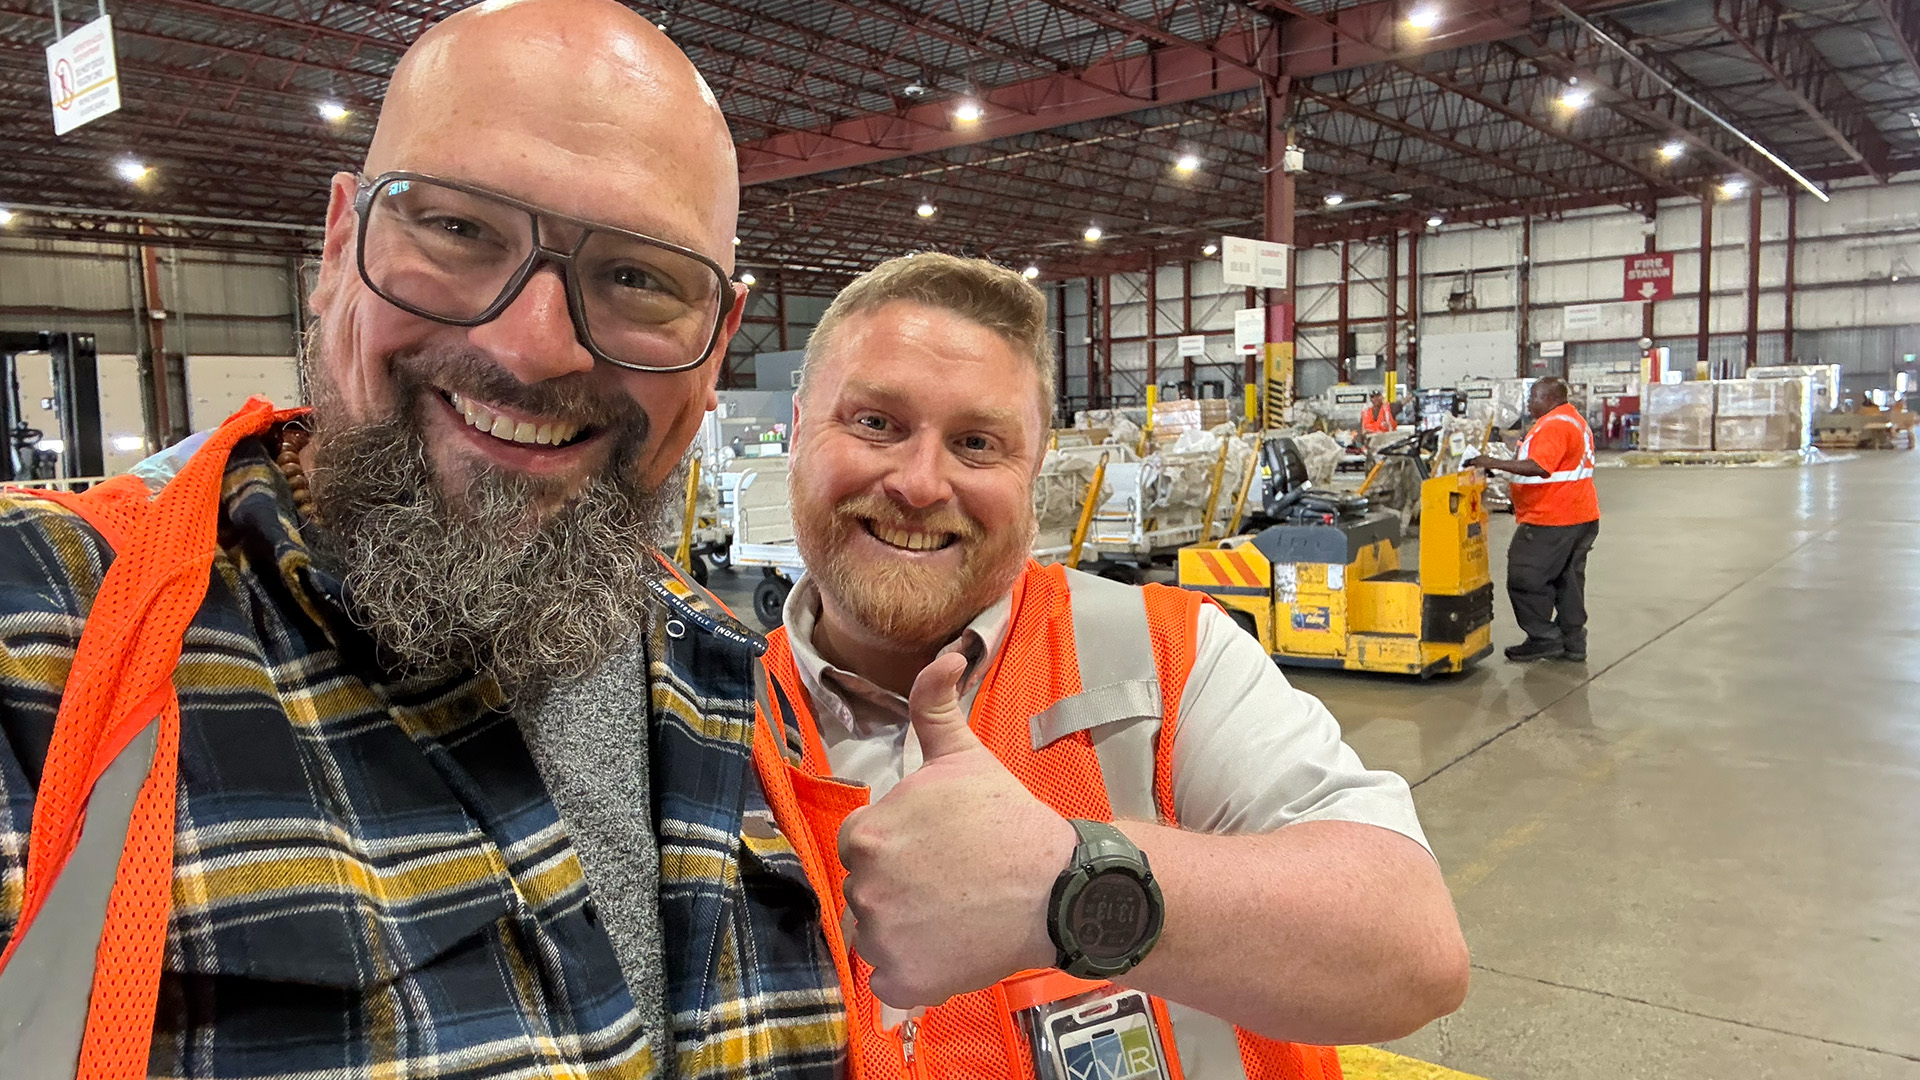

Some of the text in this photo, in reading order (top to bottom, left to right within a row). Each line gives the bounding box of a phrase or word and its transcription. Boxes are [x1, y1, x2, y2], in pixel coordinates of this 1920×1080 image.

[1628, 268, 1670, 280] STATION
[1634, 258, 1663, 269] FIRE
[648, 580, 669, 597] DIAN
[671, 598, 710, 626] MOTORCYCLE
[714, 625, 748, 643] INDIAN
[1068, 1046, 1155, 1080] YVR
